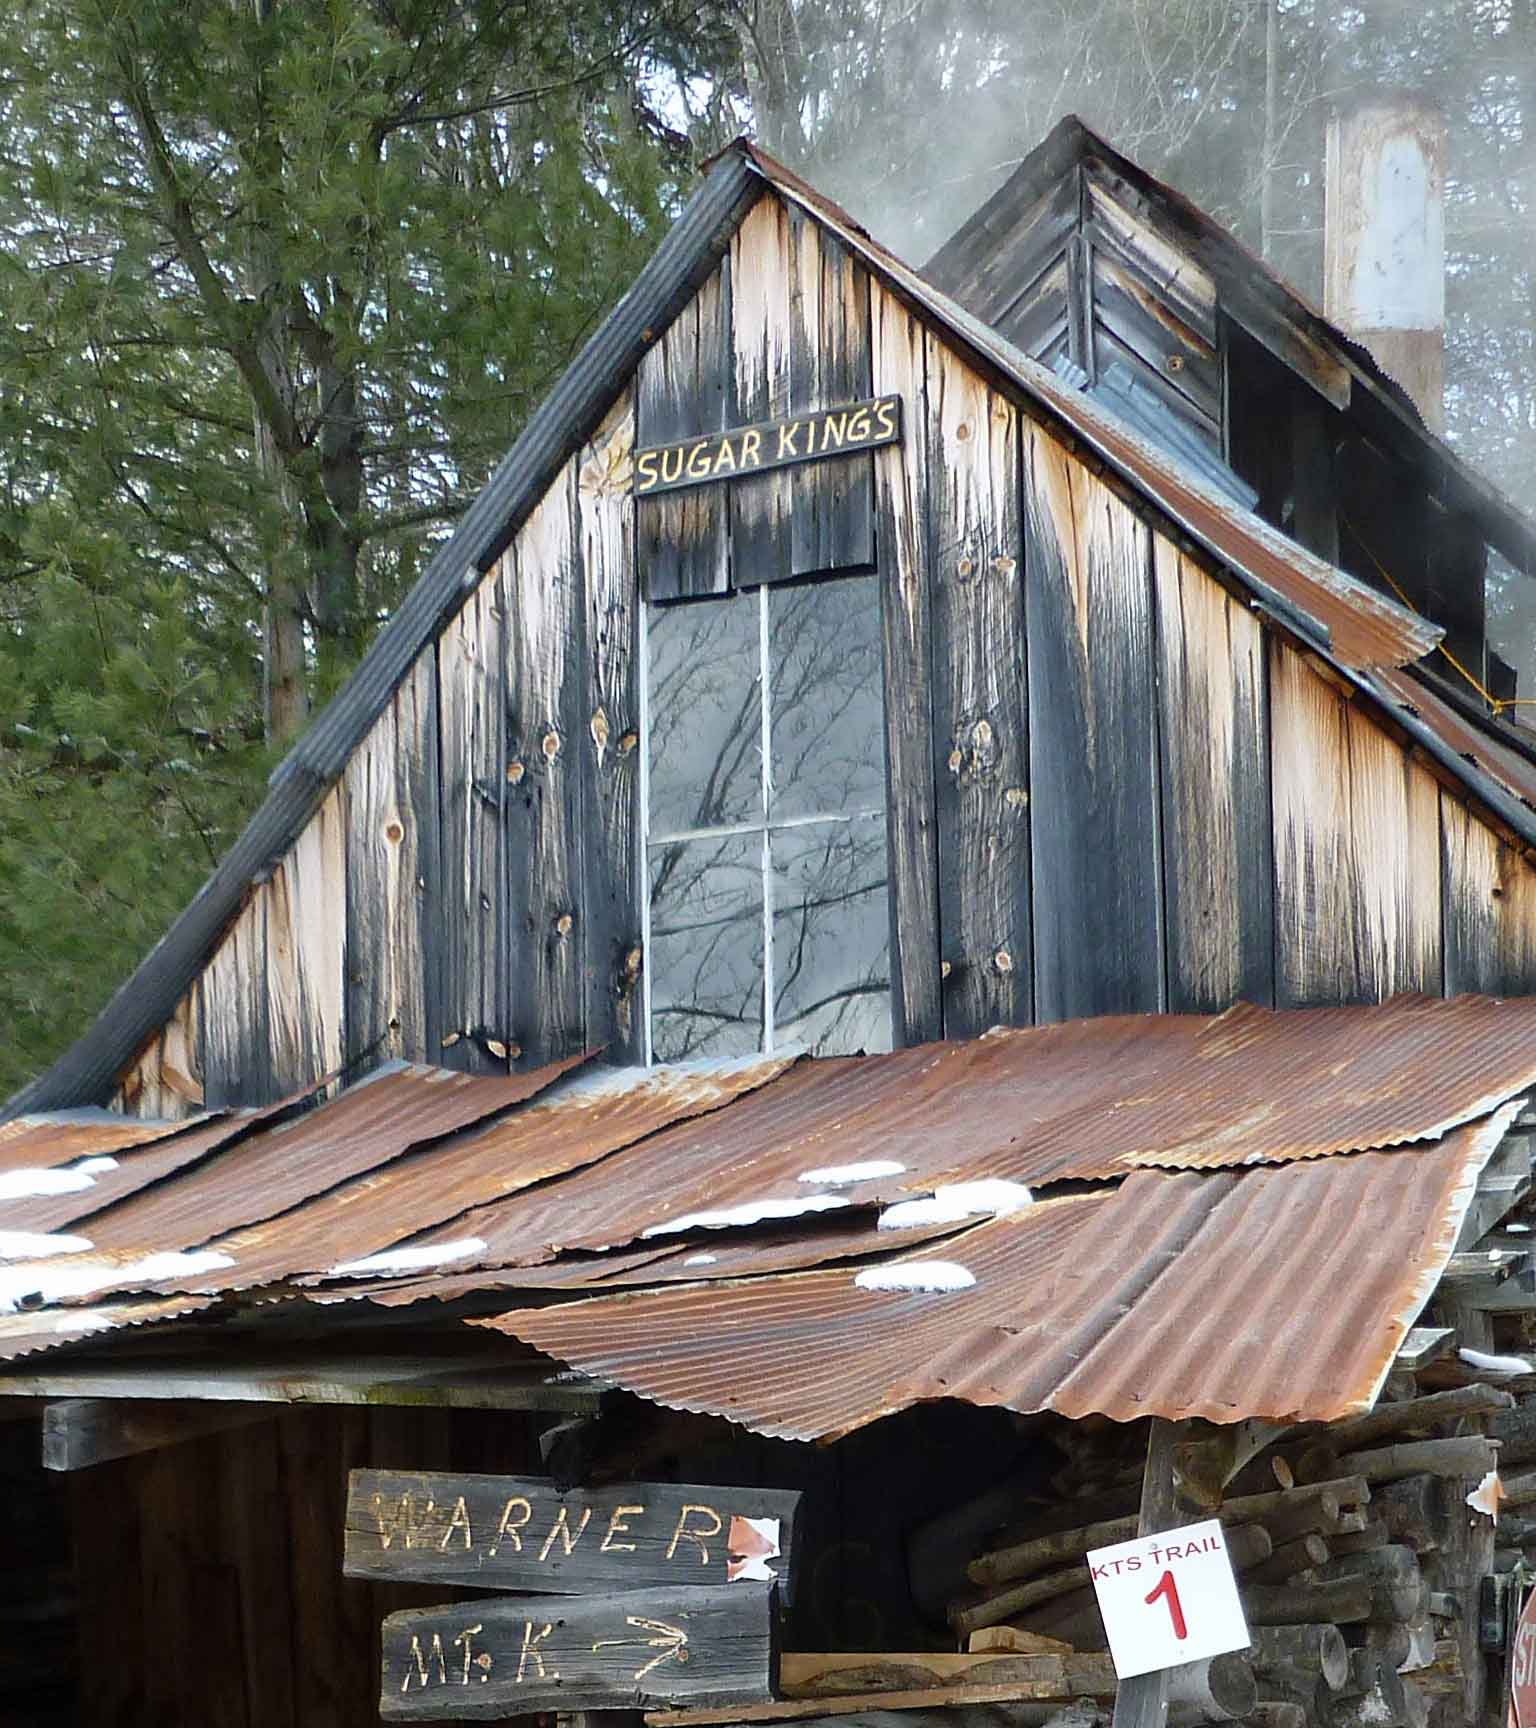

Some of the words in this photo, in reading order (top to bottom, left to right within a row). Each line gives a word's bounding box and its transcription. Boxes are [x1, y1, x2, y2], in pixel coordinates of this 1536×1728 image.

[637, 429, 762, 490] SUGAR
[776, 399, 895, 459] KING'S
[372, 1495, 724, 1565] WARNER
[1091, 1556, 1142, 1581] KTS
[1147, 1535, 1222, 1566] TRAIL
[1144, 1569, 1188, 1640] 1
